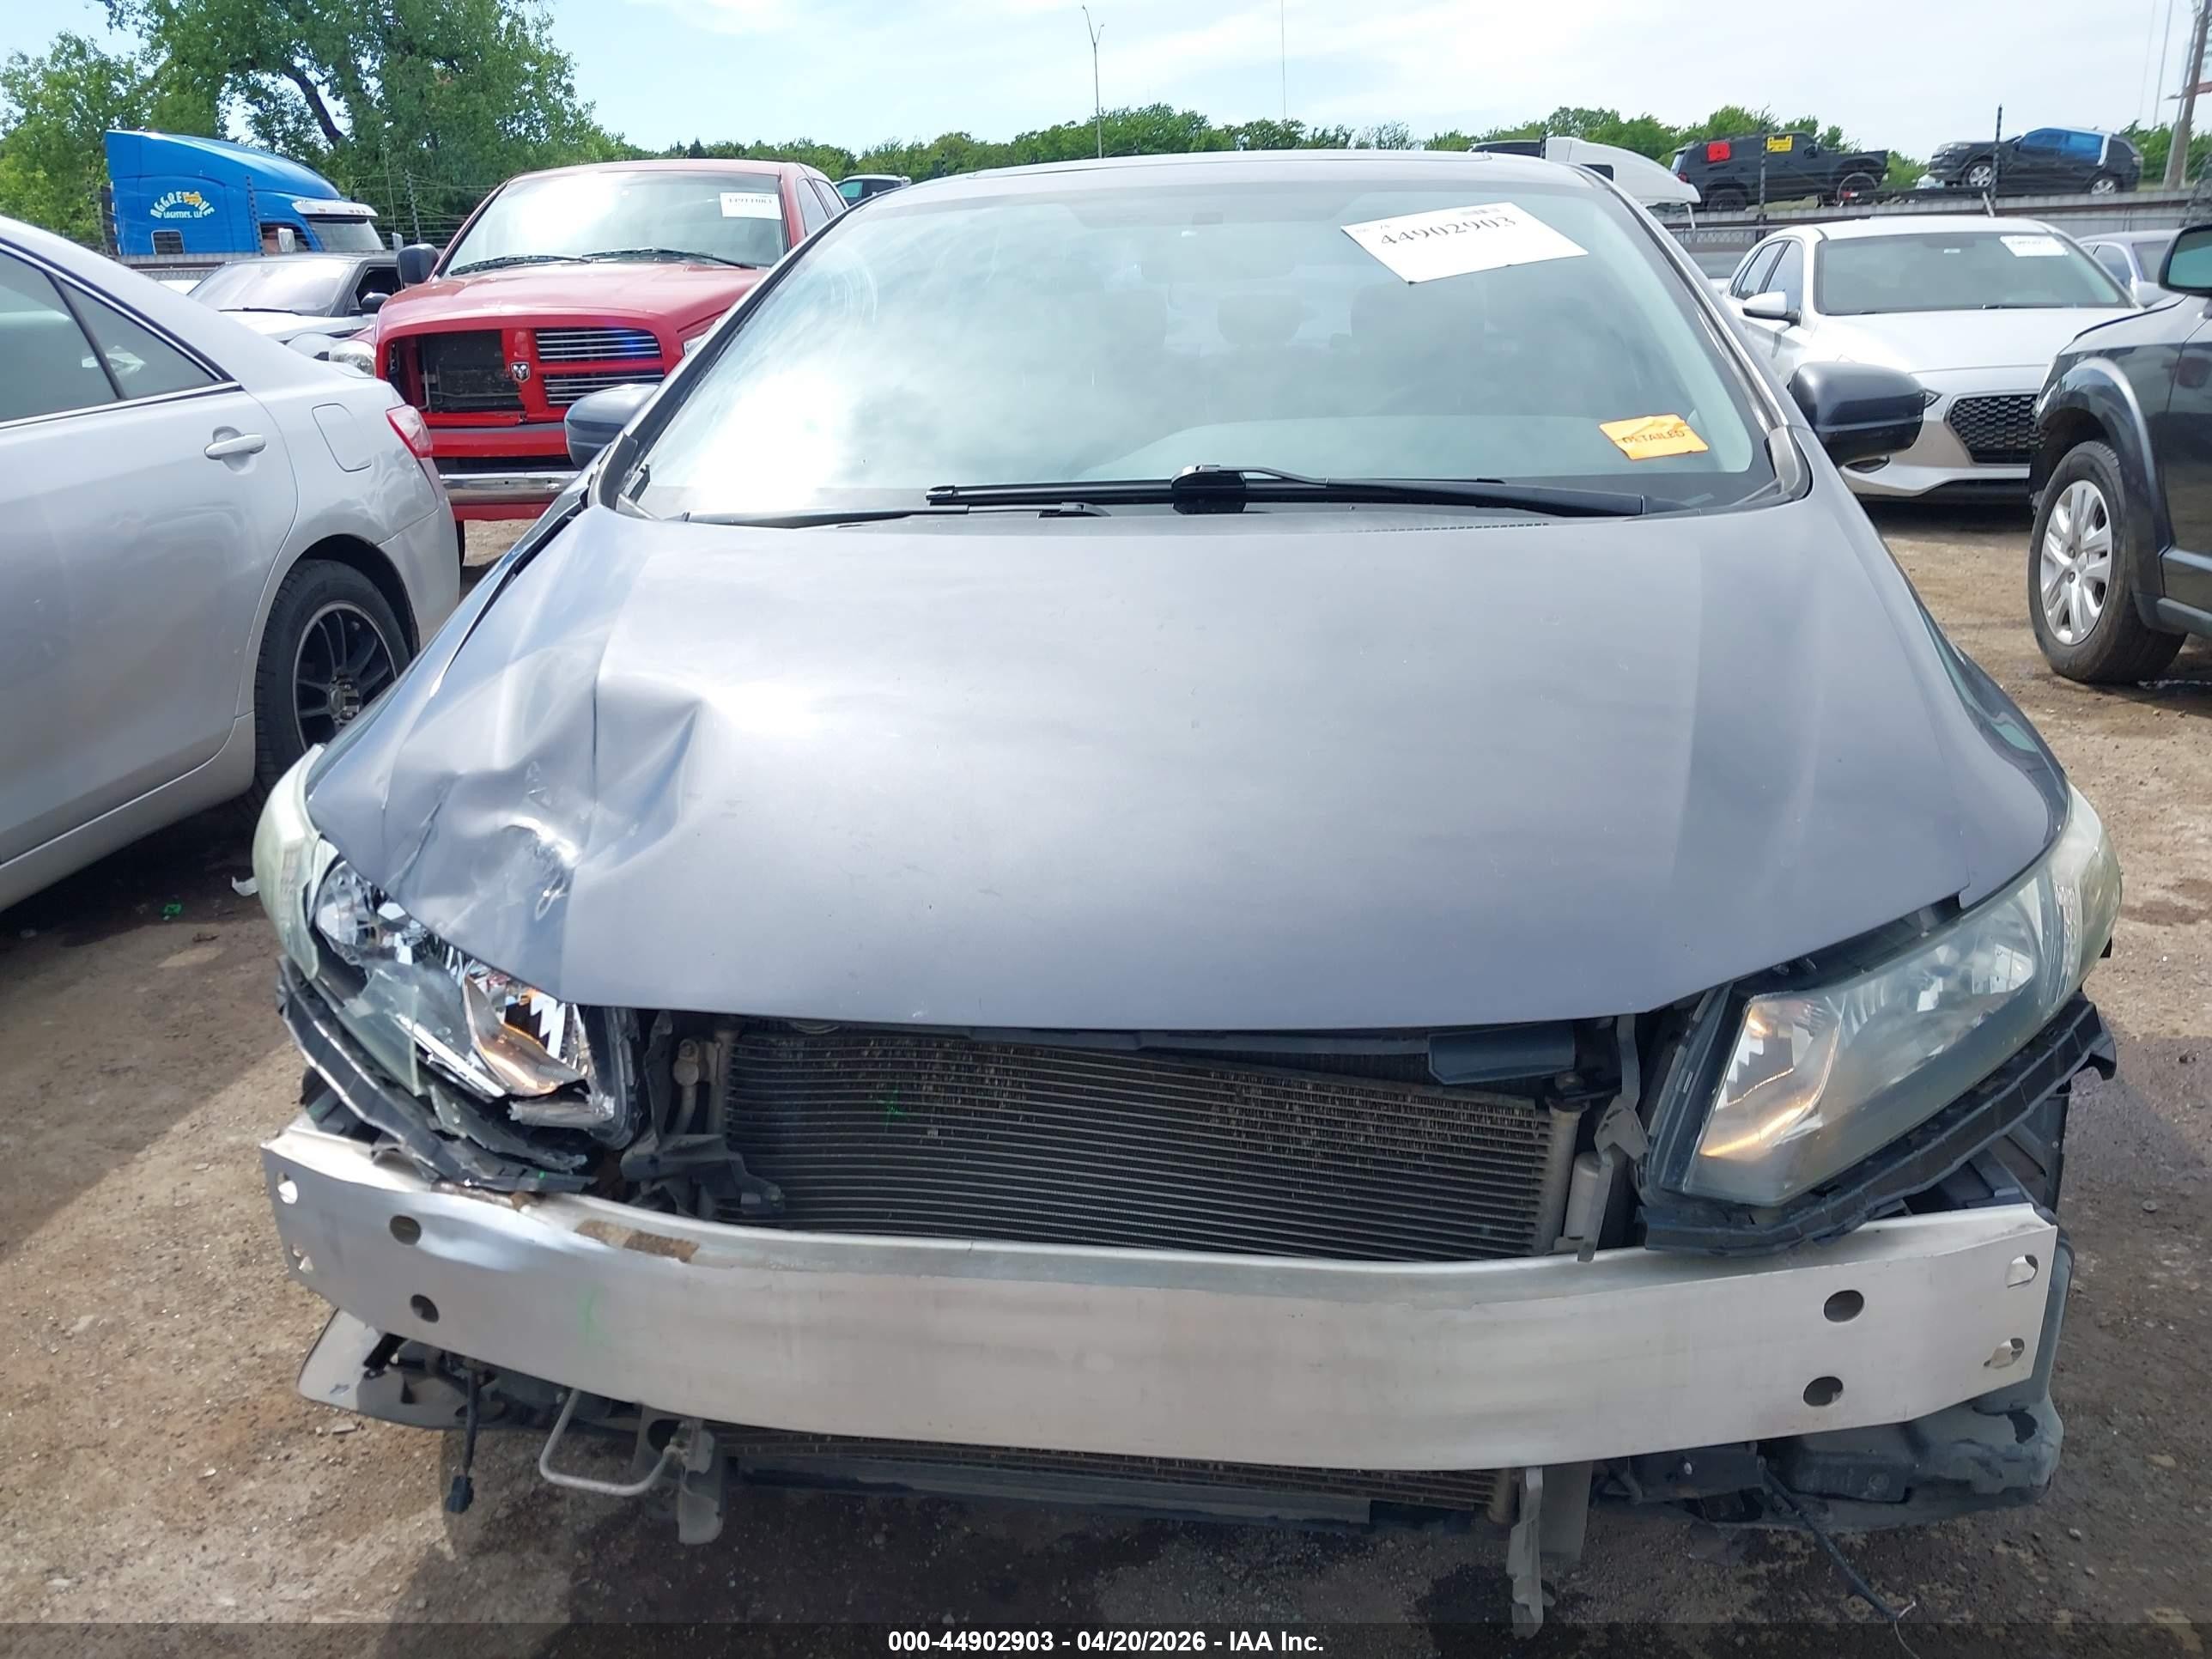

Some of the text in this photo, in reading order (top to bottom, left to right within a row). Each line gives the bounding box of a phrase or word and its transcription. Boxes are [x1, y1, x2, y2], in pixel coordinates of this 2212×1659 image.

[149, 191, 216, 219] AGGREVE
[1381, 216, 1517, 246] 44902903
[1621, 429, 1686, 444] DETAILED
